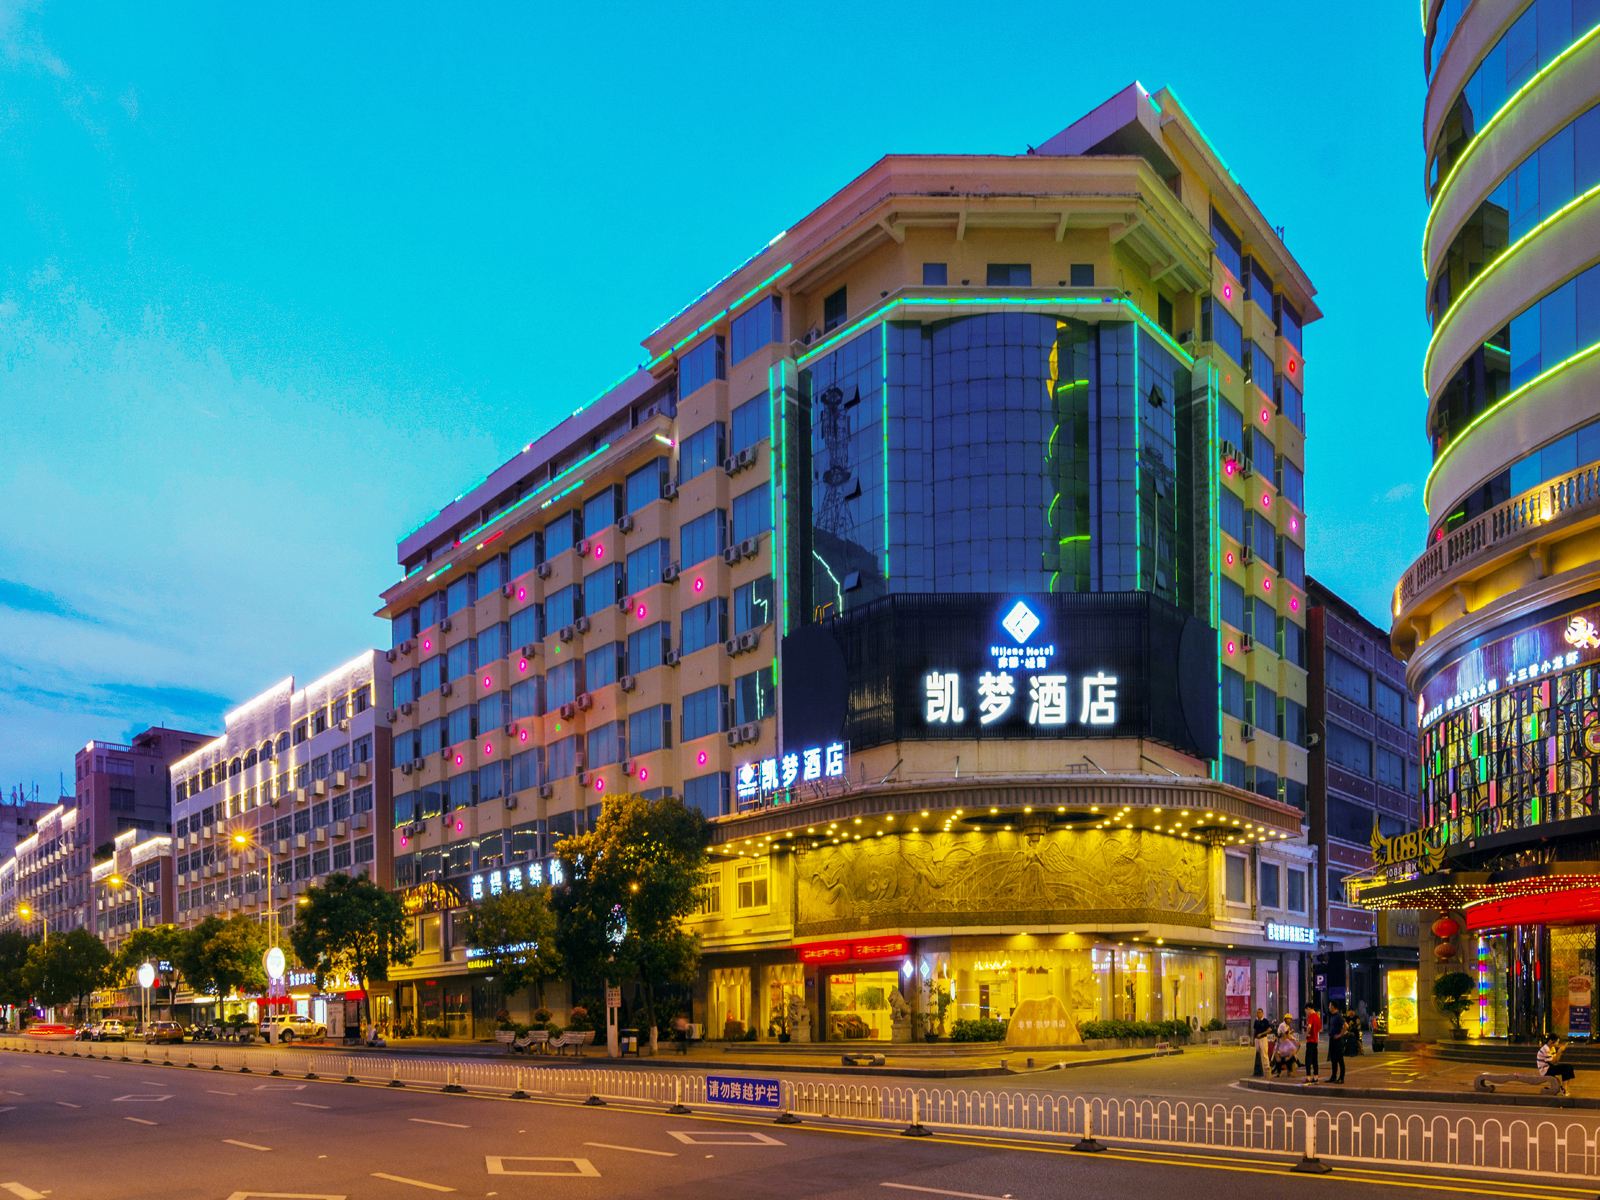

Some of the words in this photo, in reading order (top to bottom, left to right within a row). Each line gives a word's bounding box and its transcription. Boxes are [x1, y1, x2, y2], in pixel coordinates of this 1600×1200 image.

[1026, 645, 1054, 657] Hotel
[1505, 650, 1580, 685] 十三香小龙虾
[926, 671, 1118, 725] 凯梦酒店
[762, 742, 844, 789] 凯梦酒店
[1316, 975, 1324, 985] P
[709, 1080, 778, 1102] 请勿跨越护栏
